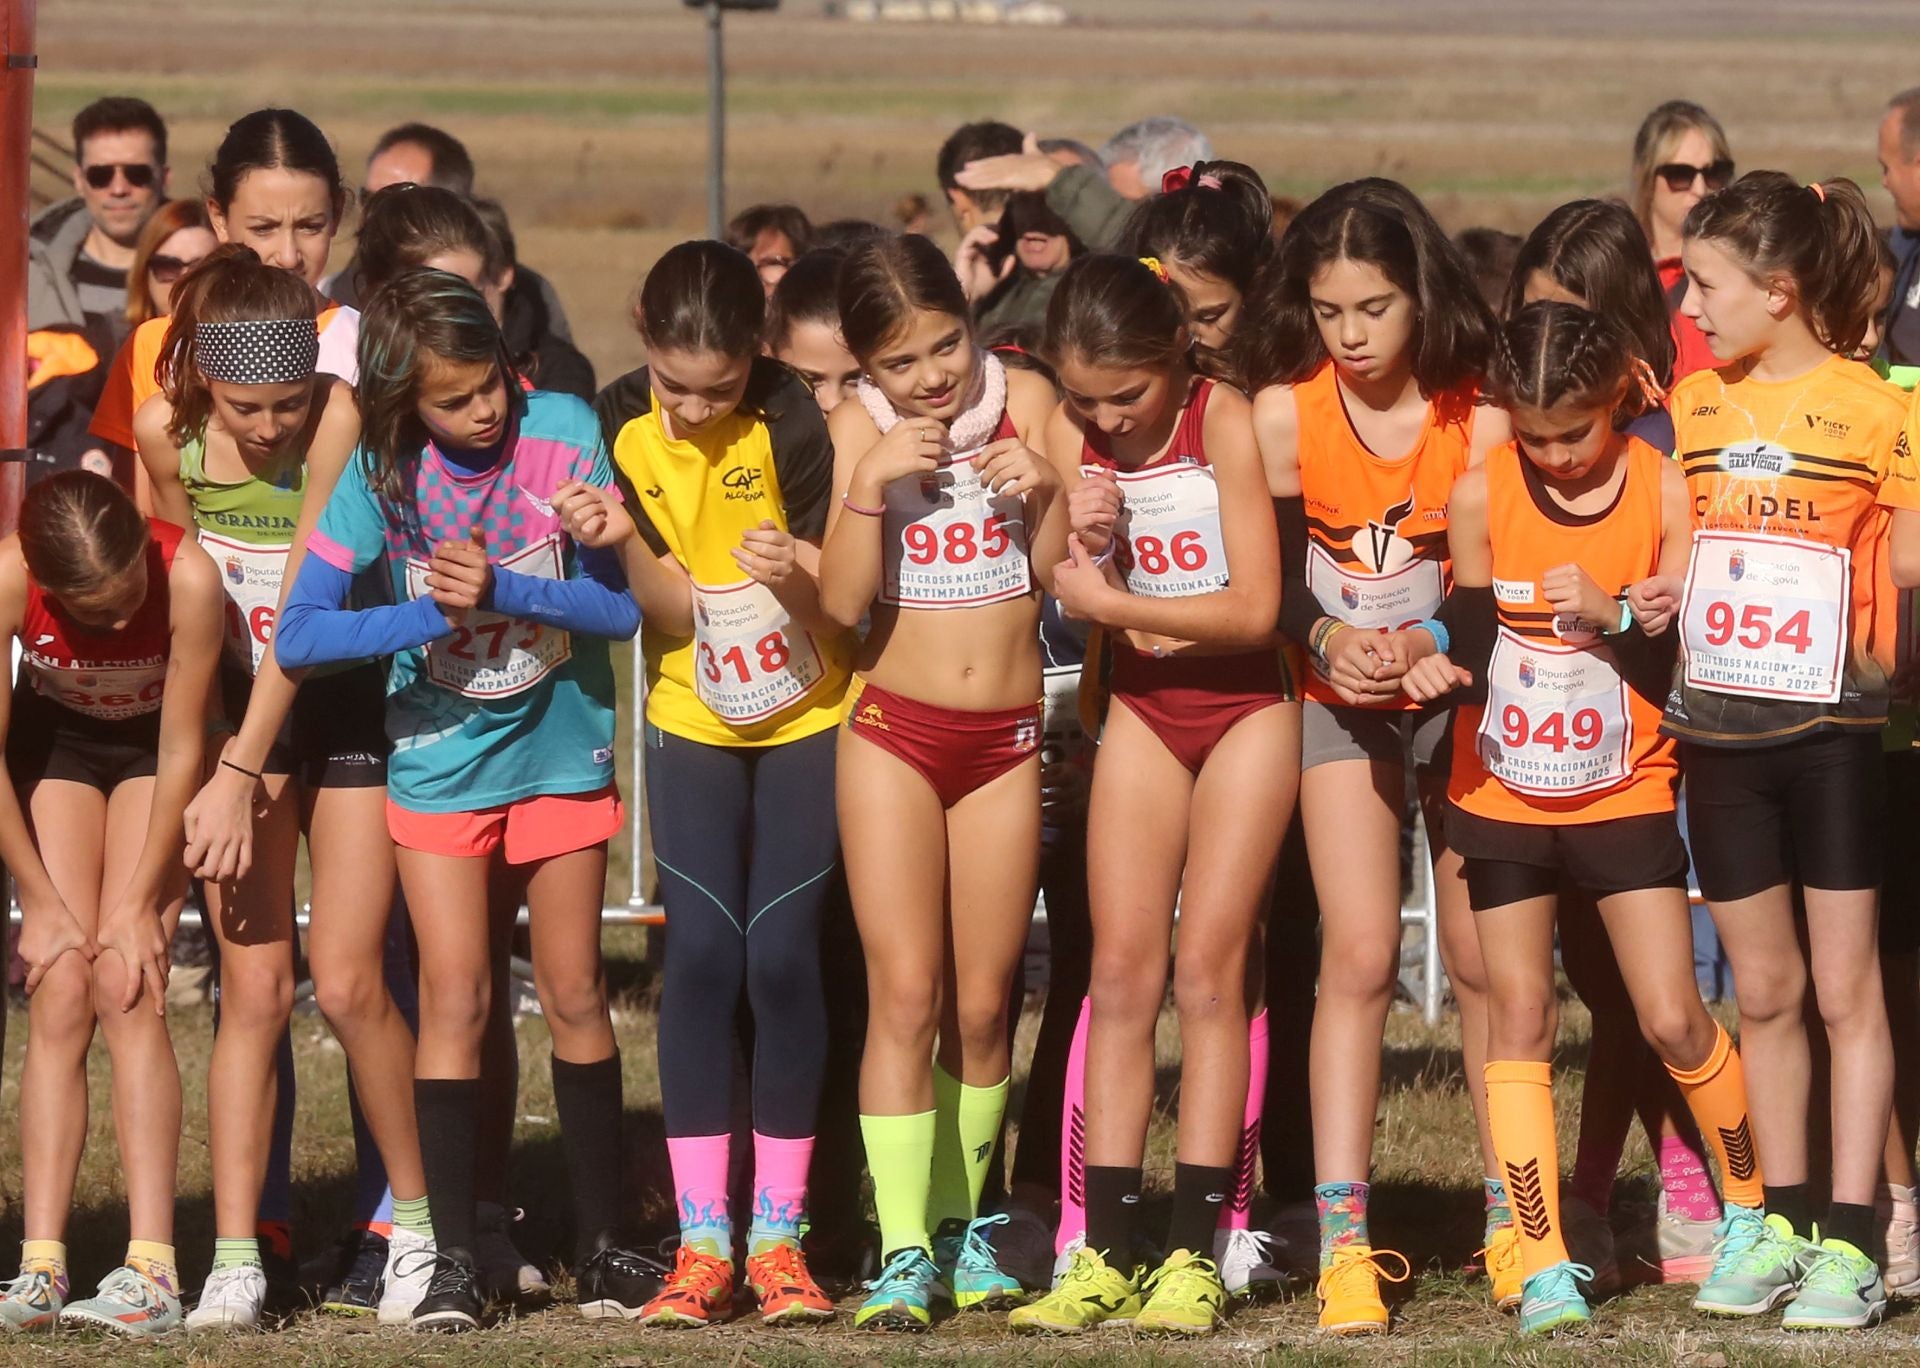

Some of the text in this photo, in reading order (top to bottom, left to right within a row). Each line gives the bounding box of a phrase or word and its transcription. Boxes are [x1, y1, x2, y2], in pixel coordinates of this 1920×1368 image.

[1823, 420, 1852, 431] VICKY
[1125, 491, 1173, 505] Diputación
[215, 512, 297, 529] GRANJA
[904, 512, 1010, 565] 985
[918, 572, 952, 585] CROSS
[956, 568, 1007, 583] NACIONAL
[1009, 559, 1022, 571] DE
[247, 578, 258, 586] de
[899, 572, 1022, 598] CANTIMPALOS 2025
[1155, 577, 1212, 593] NACIONAL
[1361, 586, 1410, 602] Diputación
[1506, 588, 1530, 596] VICKY
[708, 602, 755, 617] Diputación
[1361, 603, 1373, 611] de
[1705, 601, 1813, 654] 954
[701, 631, 790, 684] 318
[1537, 667, 1585, 679] Diputación
[1698, 667, 1776, 687] CANTIMPALOS
[1809, 666, 1823, 677] DE
[742, 671, 796, 701] NACIONAL
[1537, 680, 1549, 689] de
[1502, 704, 1604, 753] 949
[1508, 757, 1541, 771] CROSS
[1543, 758, 1599, 773] NACIONAL
[1601, 752, 1613, 764] DE
[1492, 764, 1610, 786] CANTIMPALOS 2025
